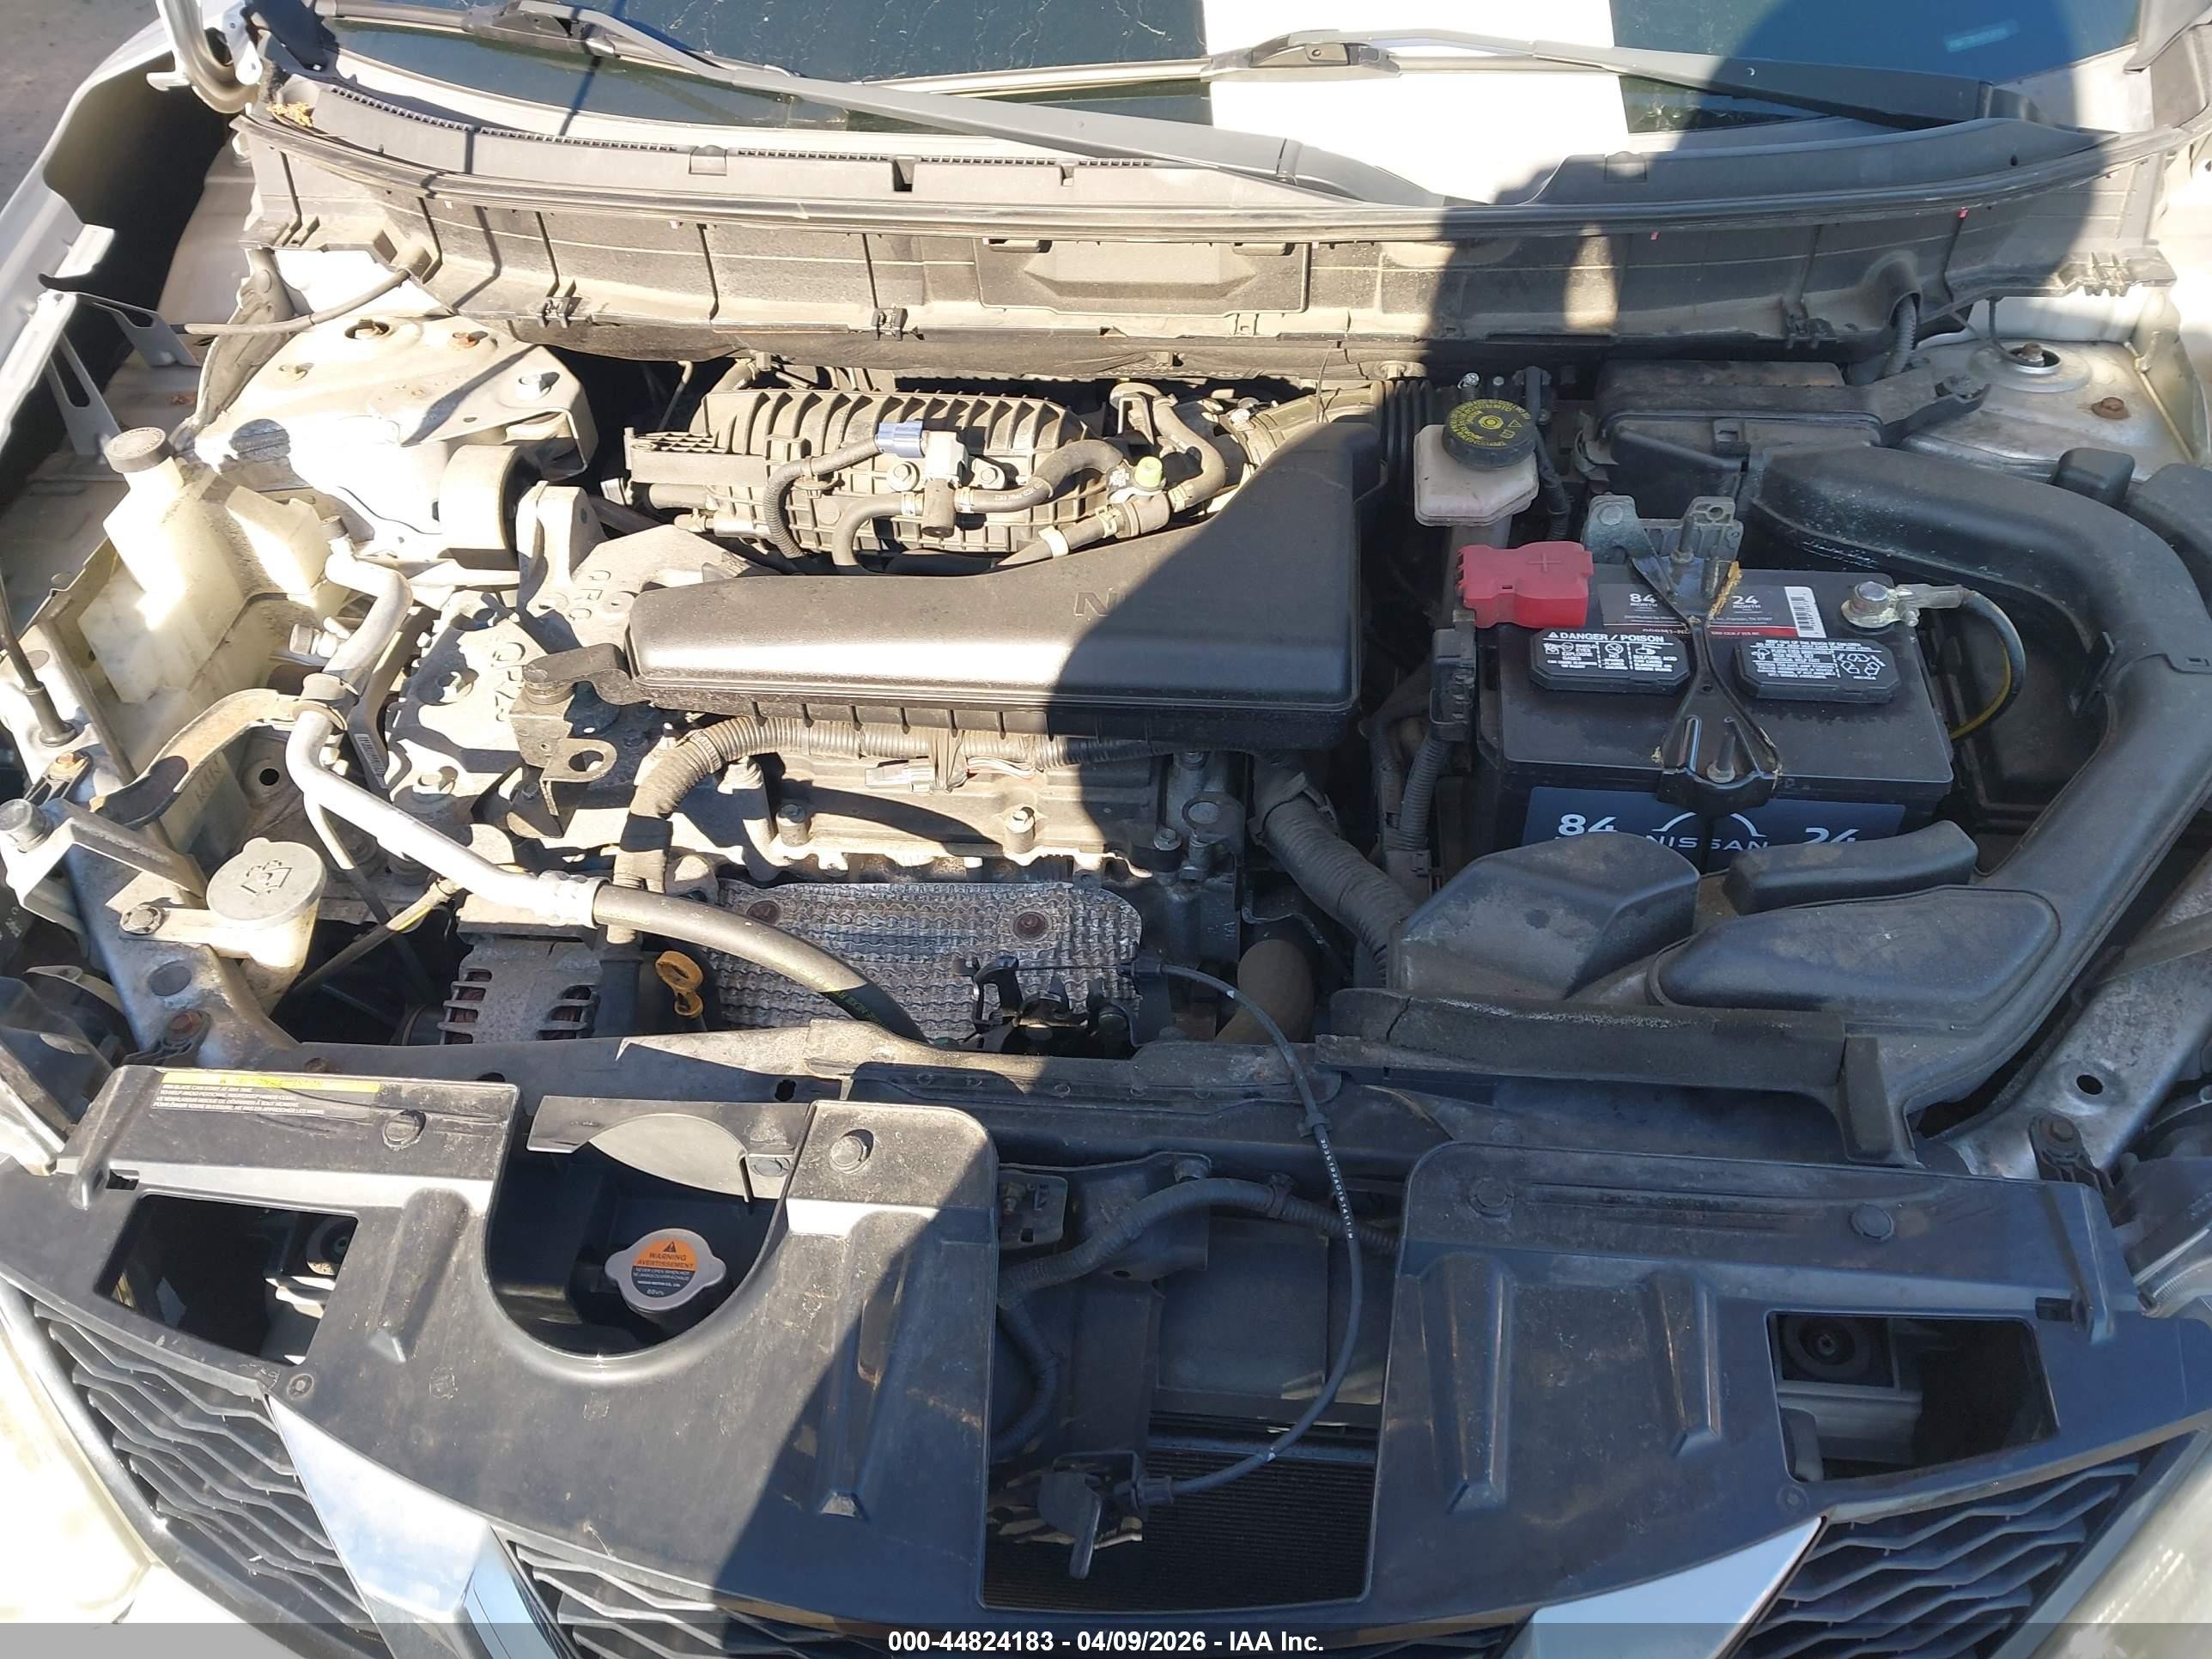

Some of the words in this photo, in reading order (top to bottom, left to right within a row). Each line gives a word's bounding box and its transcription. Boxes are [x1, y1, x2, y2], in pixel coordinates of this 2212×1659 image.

[1630, 593, 1657, 603] 84
[1731, 595, 1759, 605] 24
[1559, 632, 1608, 641] DANGER
[1559, 814, 1617, 836] 84
[649, 1252, 687, 1261] WARNING
[637, 1259, 694, 1268] AVERTISSEMENT
